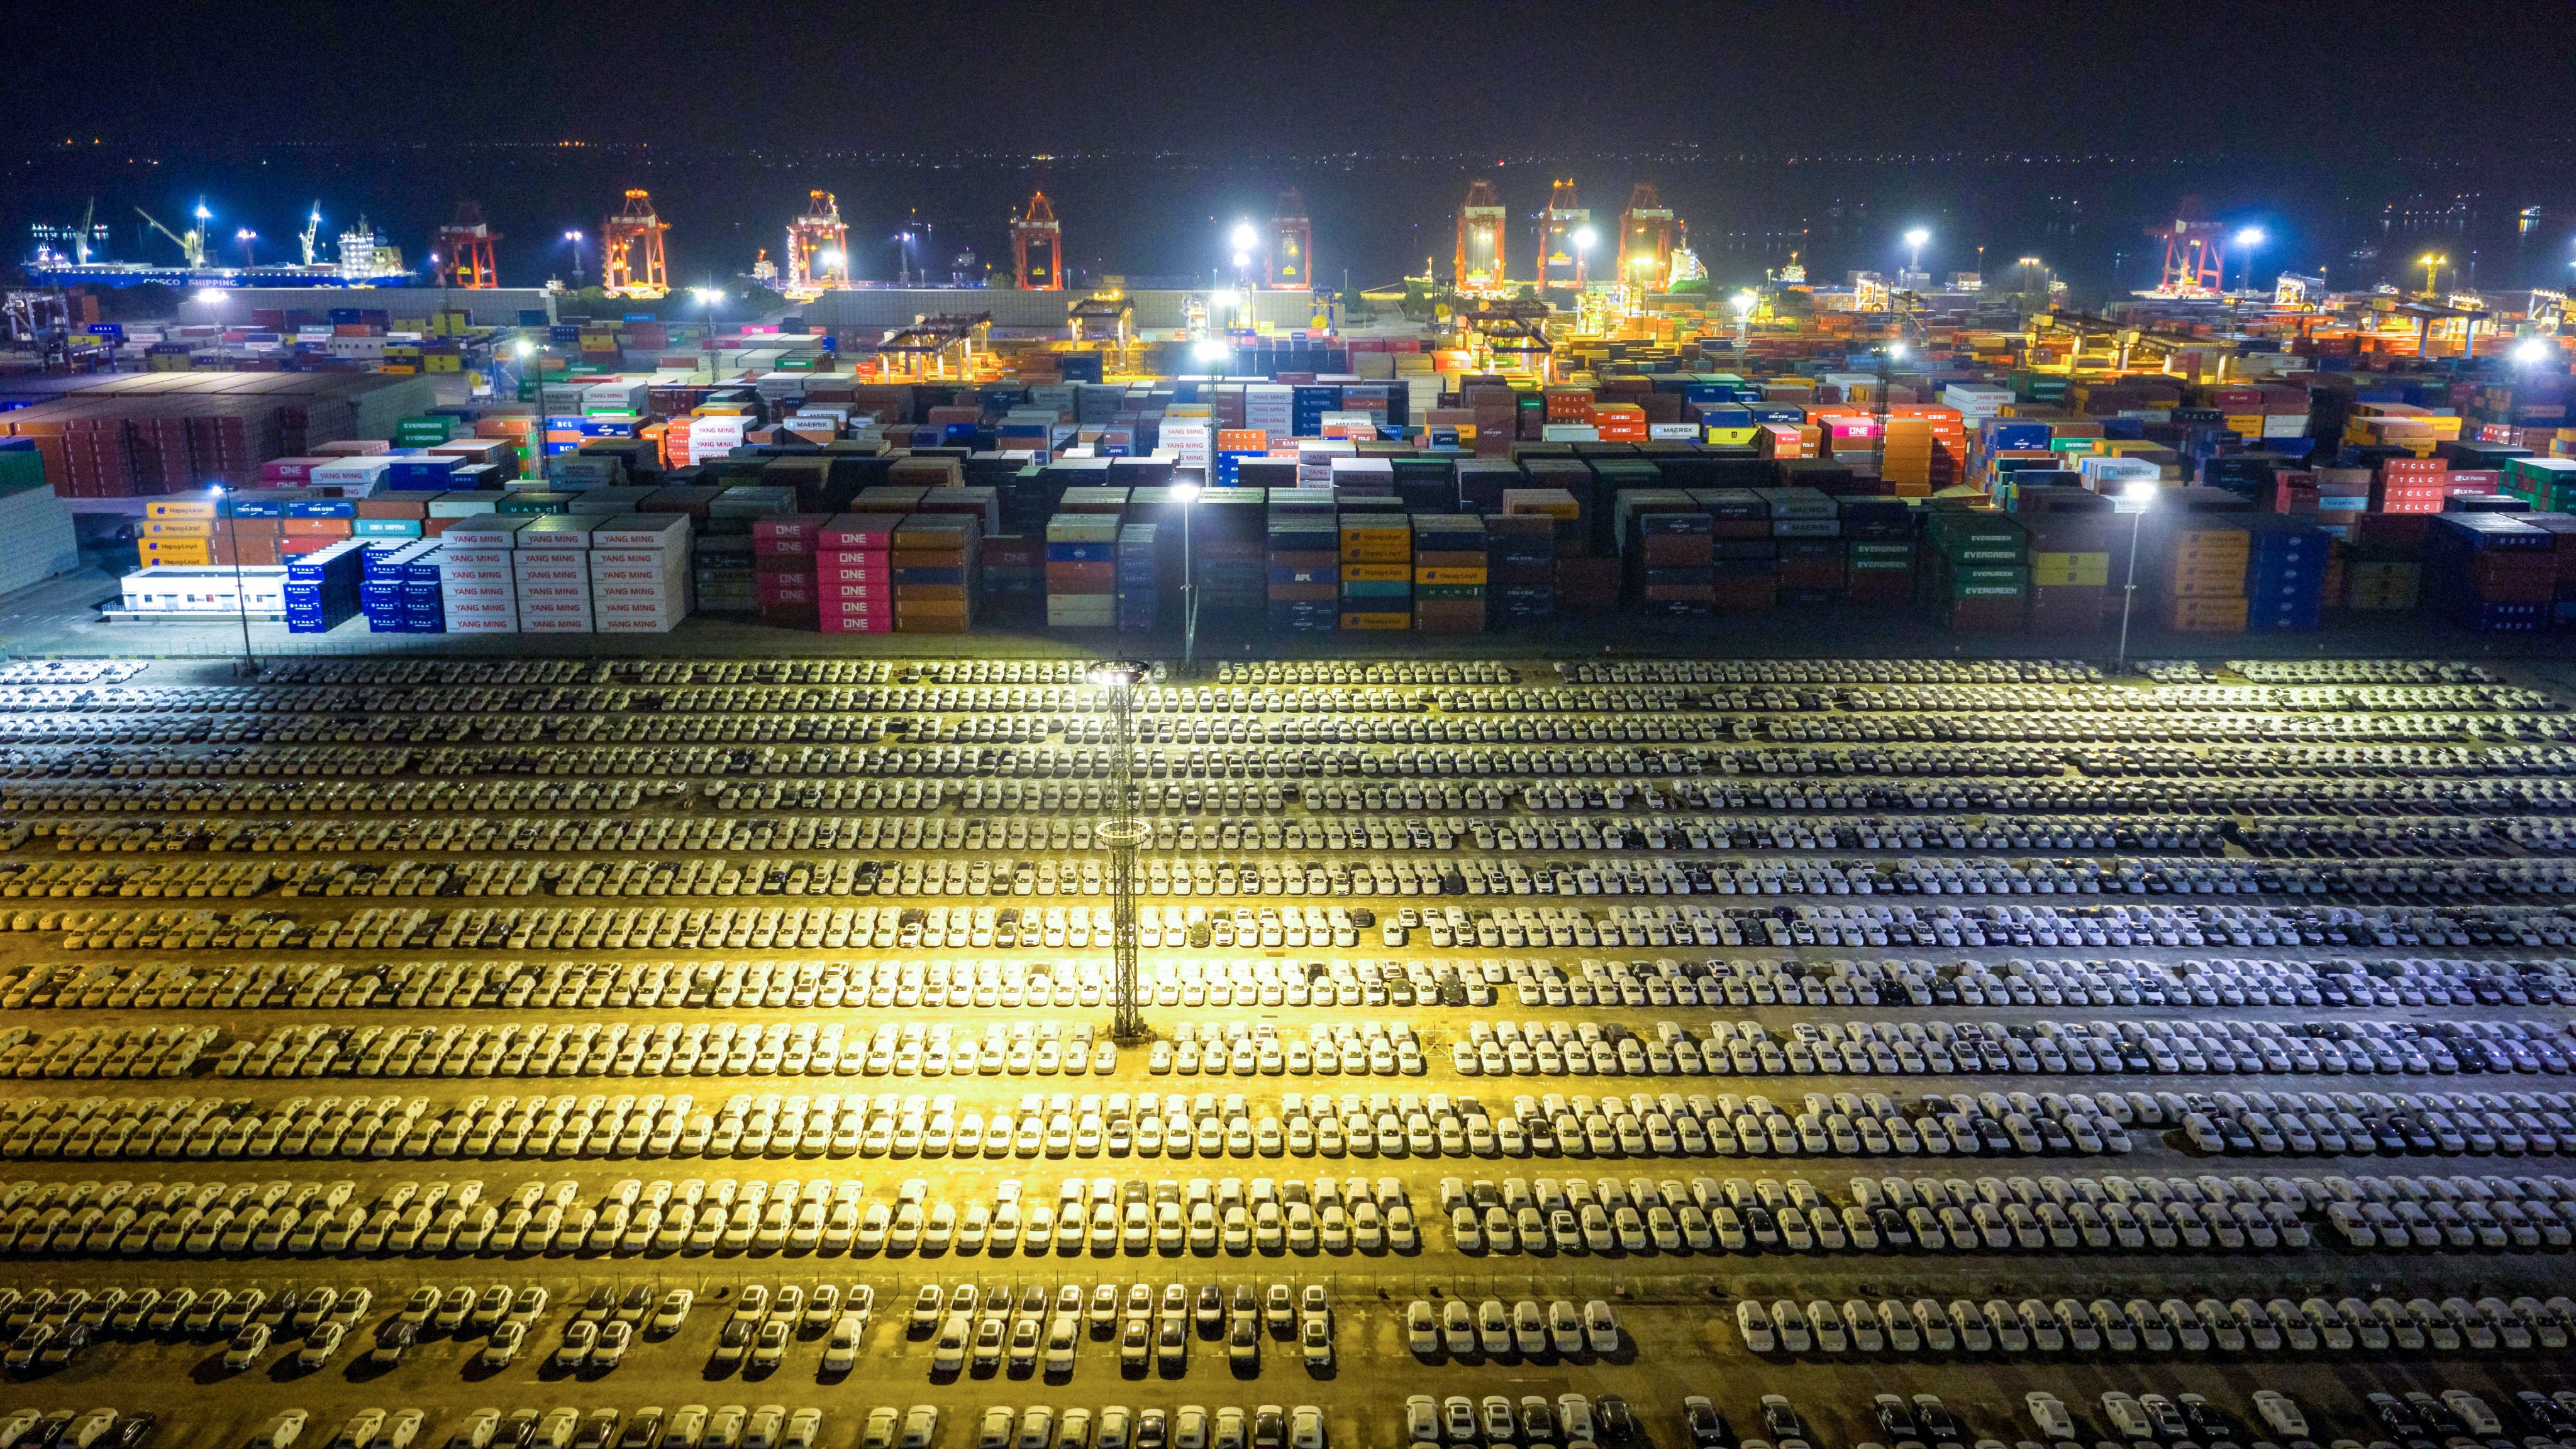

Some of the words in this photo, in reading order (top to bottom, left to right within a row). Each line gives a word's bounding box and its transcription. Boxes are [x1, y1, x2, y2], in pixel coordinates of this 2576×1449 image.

[1849, 427, 1868, 435] ONE
[776, 526, 800, 535] ONE
[841, 533, 866, 543] ONE
[1364, 533, 1401, 541] Hapag-Lloyd
[777, 541, 801, 552] ONE
[840, 553, 864, 563] ONE
[1004, 553, 1028, 562] ONE
[780, 574, 804, 584] ONE
[841, 569, 865, 579] ONE
[454, 587, 477, 596] YANG
[480, 587, 503, 596] MING
[528, 587, 552, 596] YANG
[555, 587, 578, 596] MING
[604, 587, 628, 596] YANG
[631, 587, 654, 596] MING
[780, 590, 805, 600] ONE
[841, 586, 866, 596] ONE
[843, 602, 867, 612] ONE
[843, 618, 868, 628] ONE
